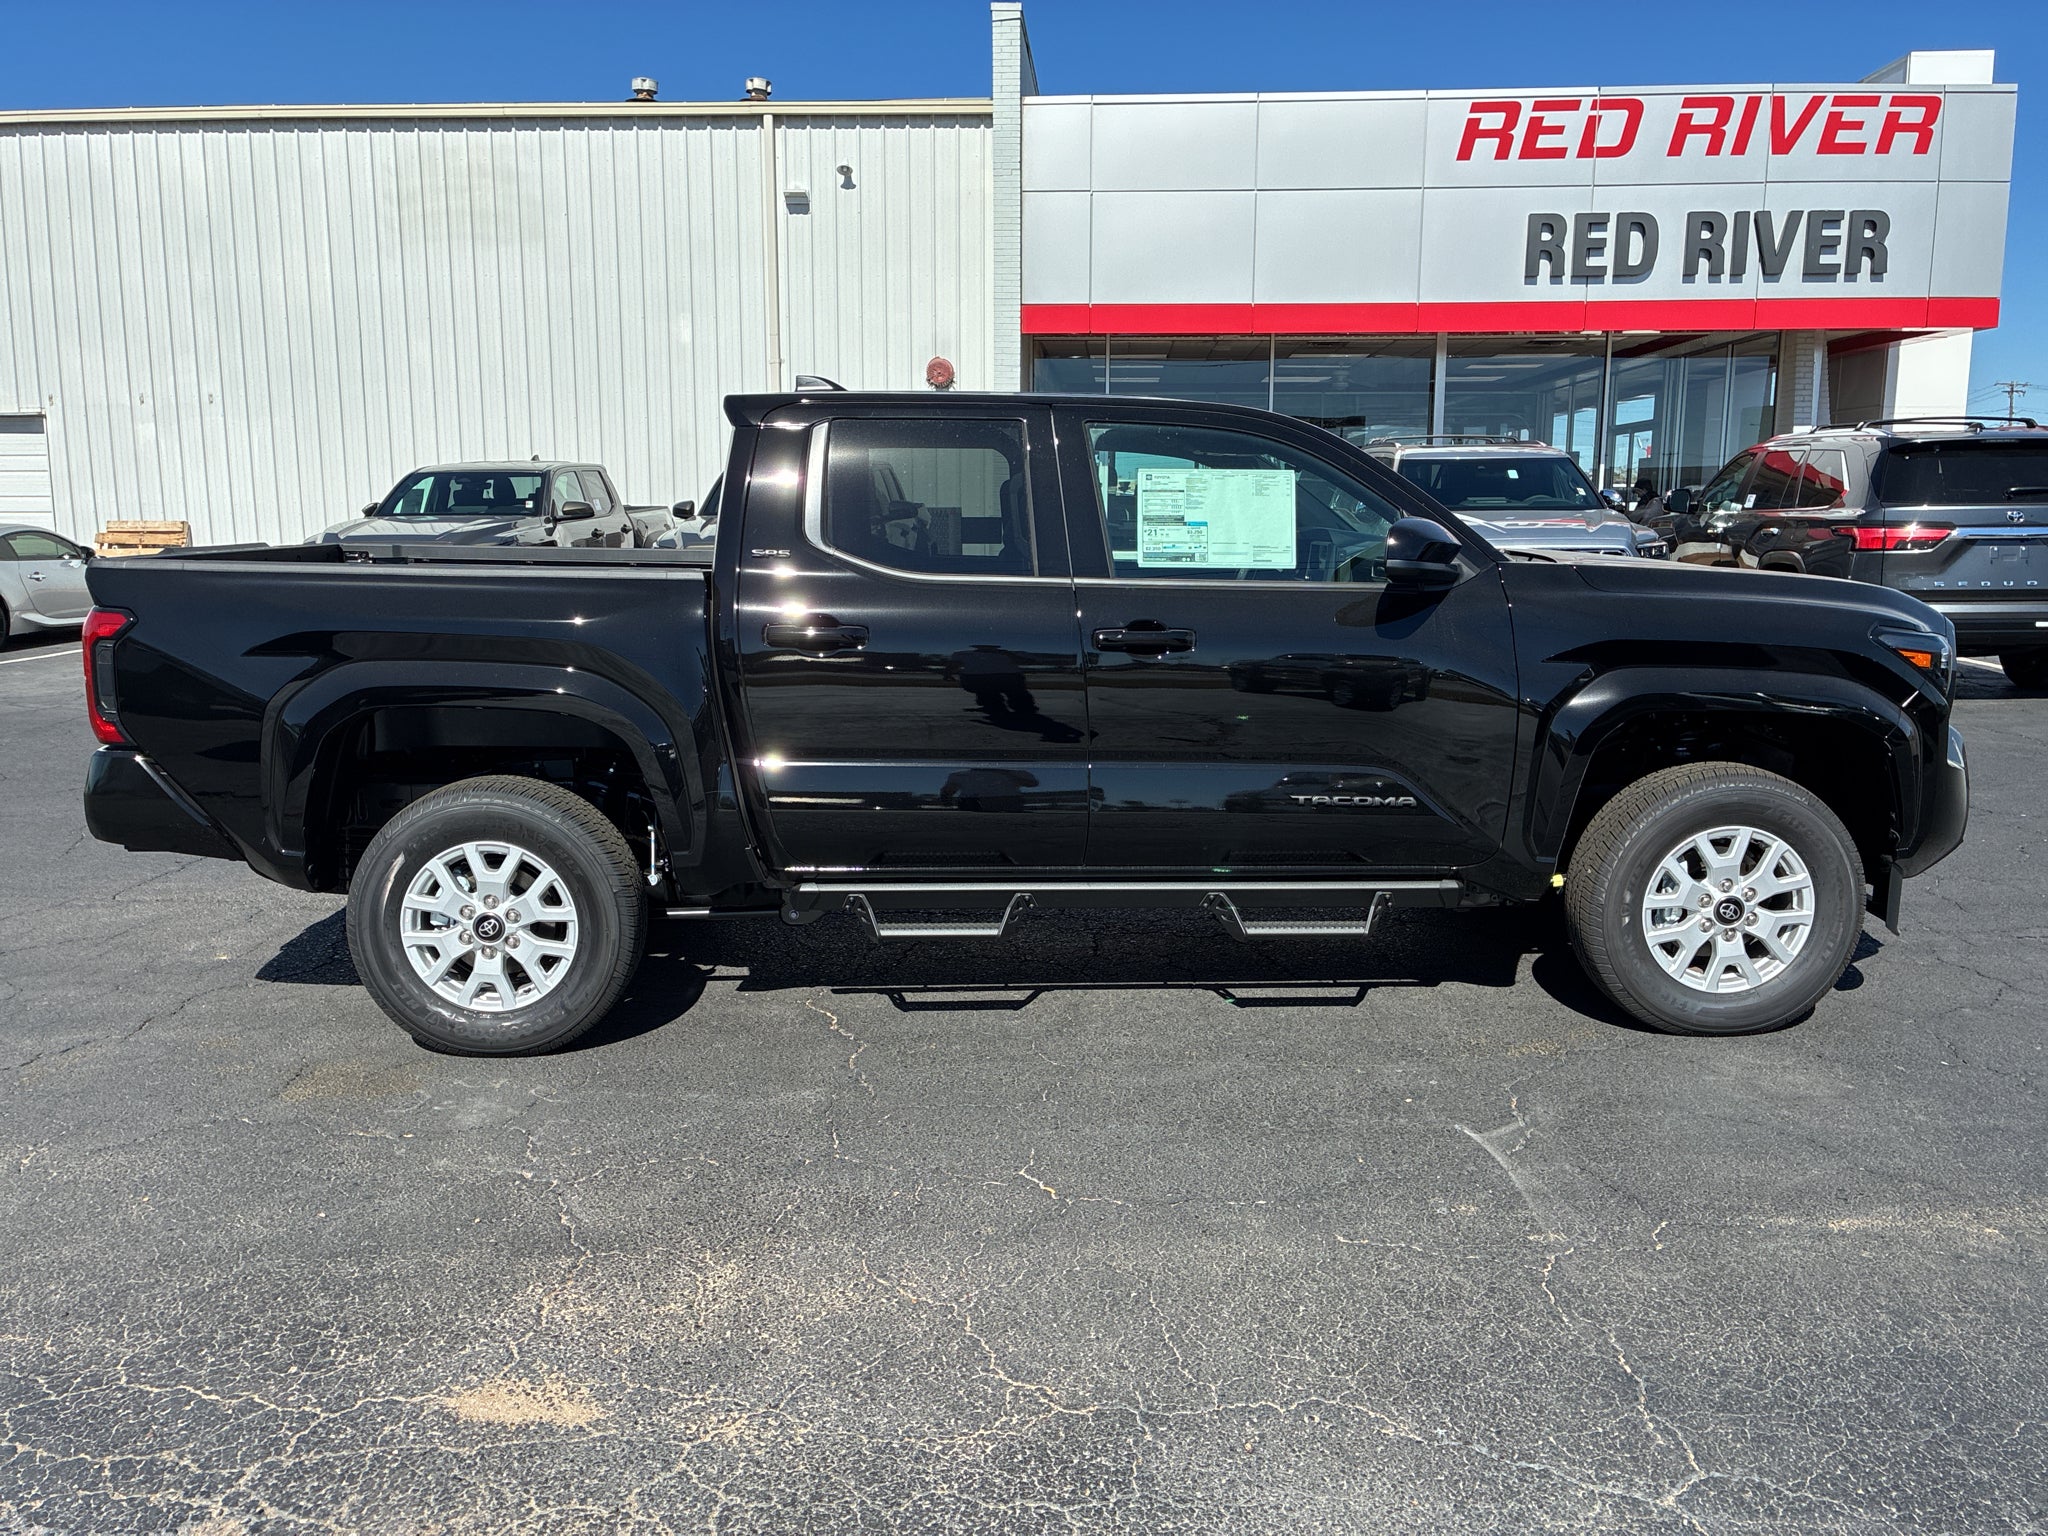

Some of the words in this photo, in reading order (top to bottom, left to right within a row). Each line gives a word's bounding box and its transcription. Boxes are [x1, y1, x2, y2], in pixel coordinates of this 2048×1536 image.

[1456, 97, 1645, 161] RED
[1666, 94, 1943, 157] RIVER
[1524, 212, 1660, 279] RED
[1682, 209, 1891, 278] RIVER
[1290, 794, 1418, 808] TACOMA
